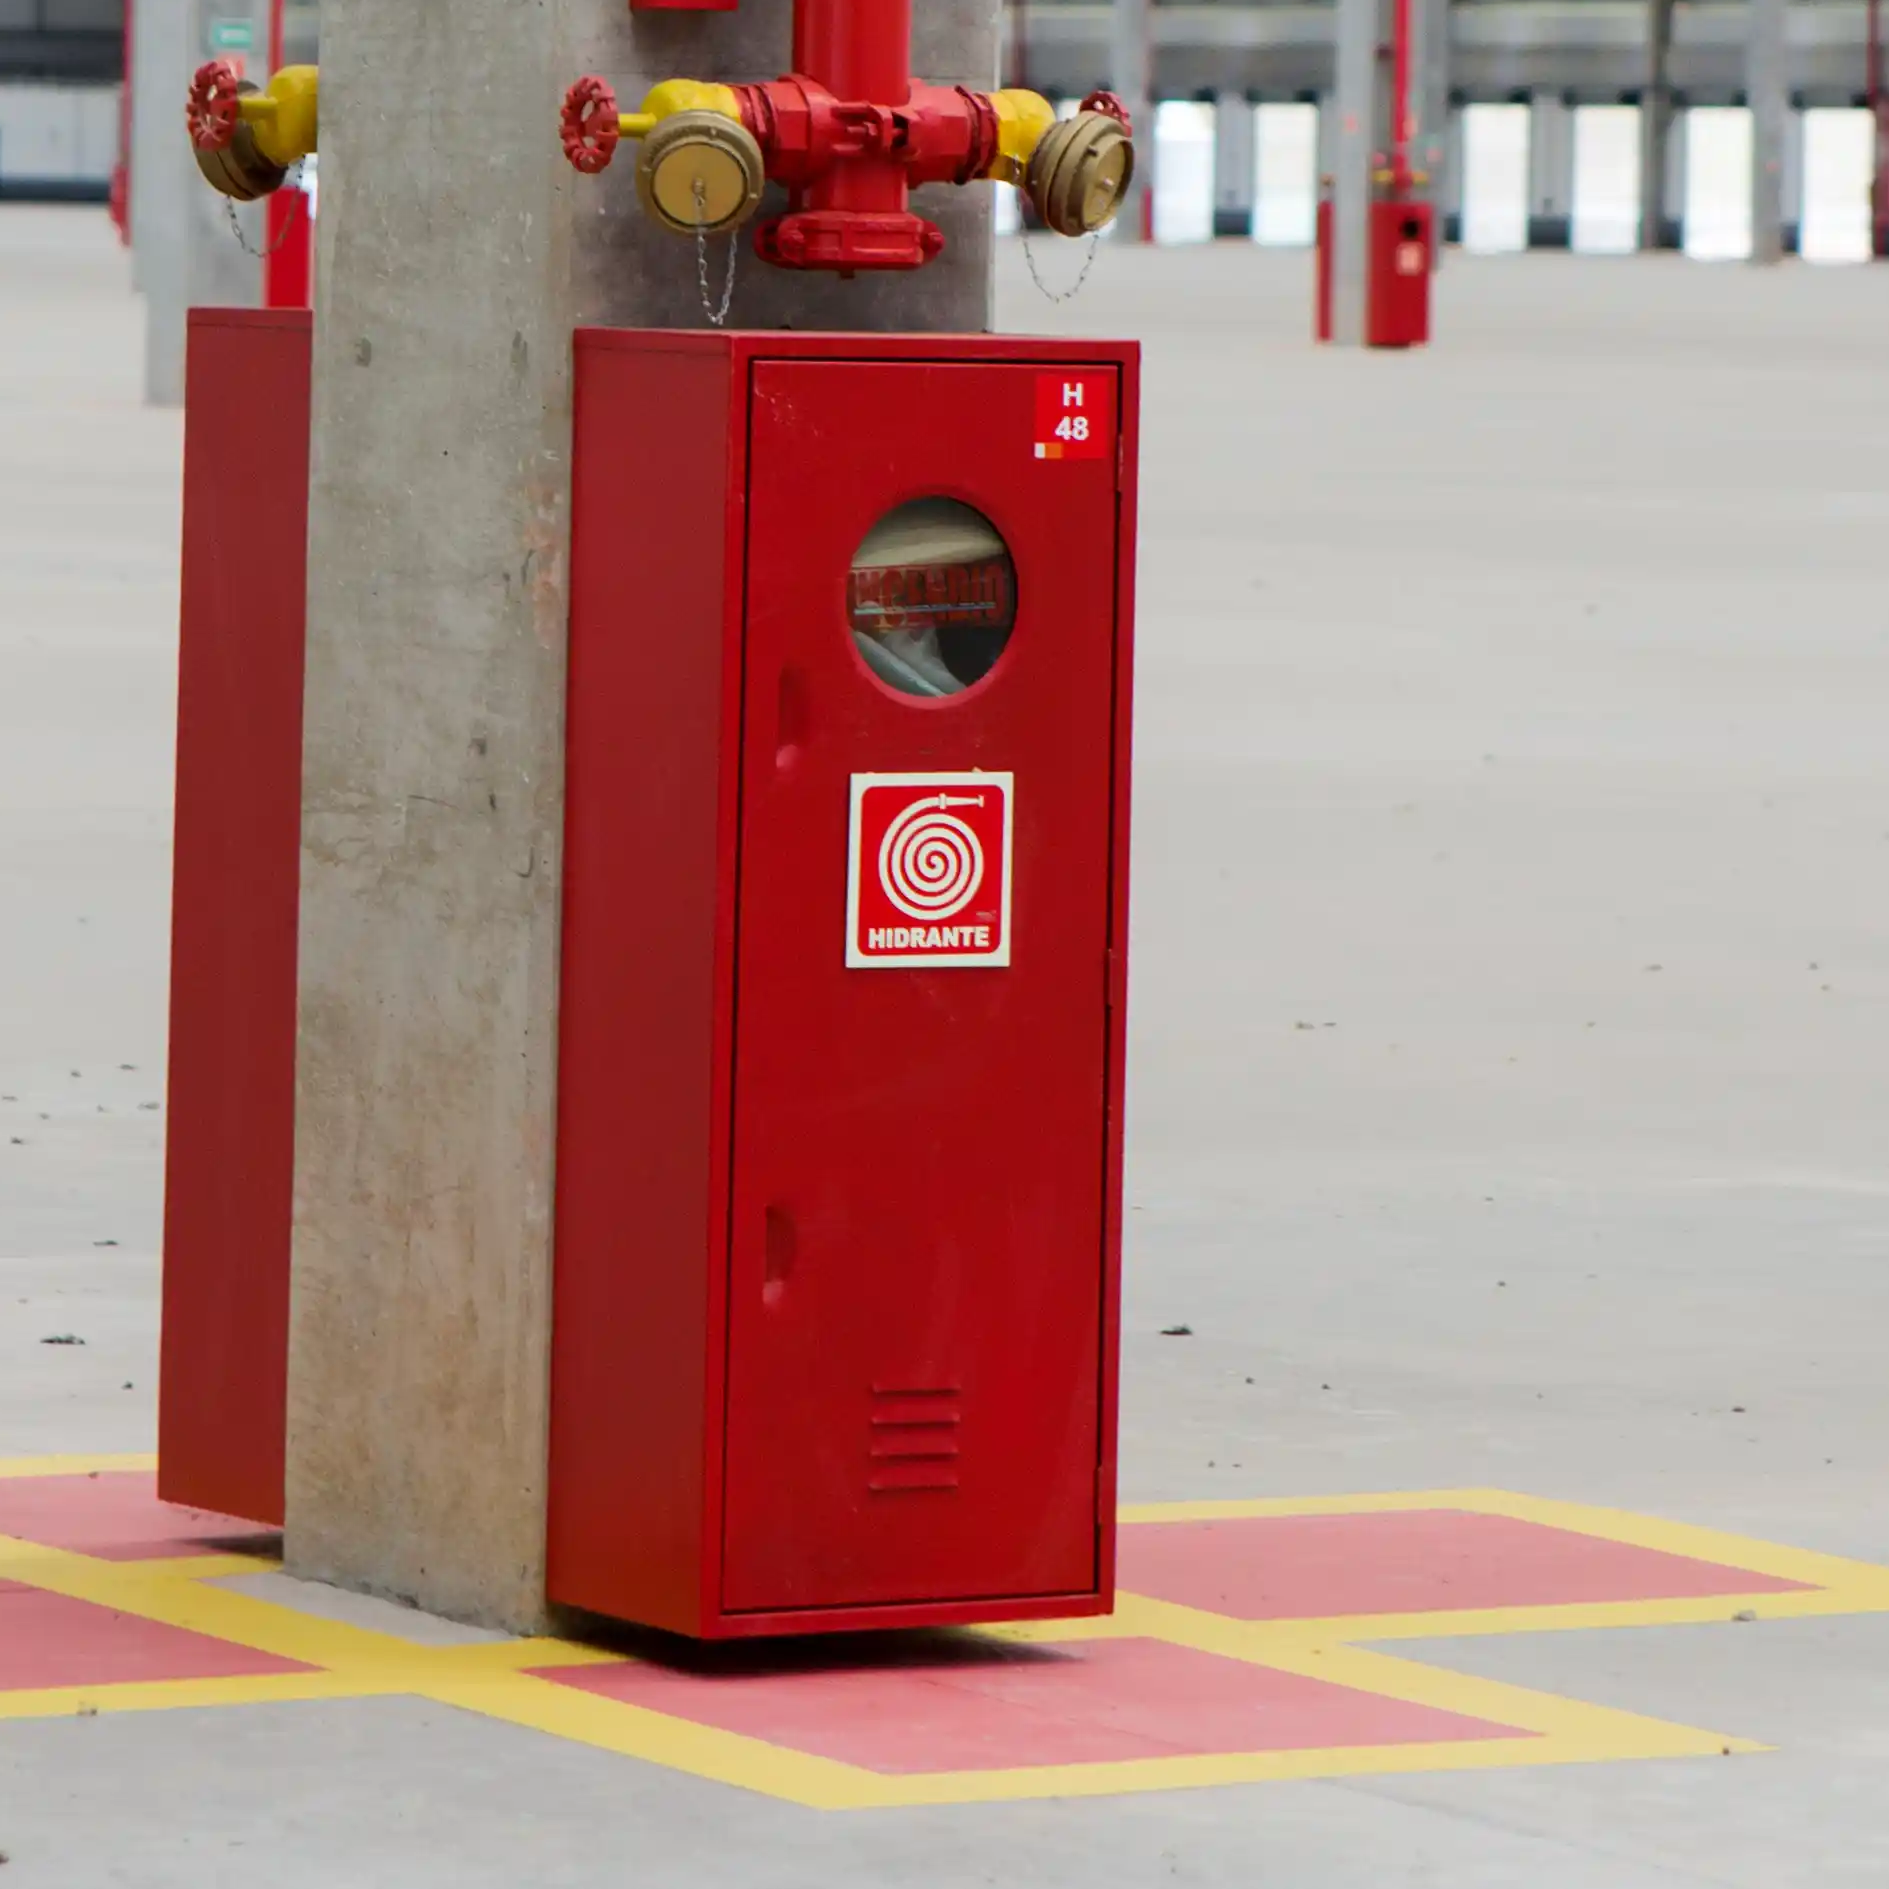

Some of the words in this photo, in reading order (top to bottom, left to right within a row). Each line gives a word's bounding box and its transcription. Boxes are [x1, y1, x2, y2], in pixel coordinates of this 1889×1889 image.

[1063, 382, 1084, 407] H
[1054, 415, 1090, 441] 48
[868, 925, 990, 950] HIDRANTE
